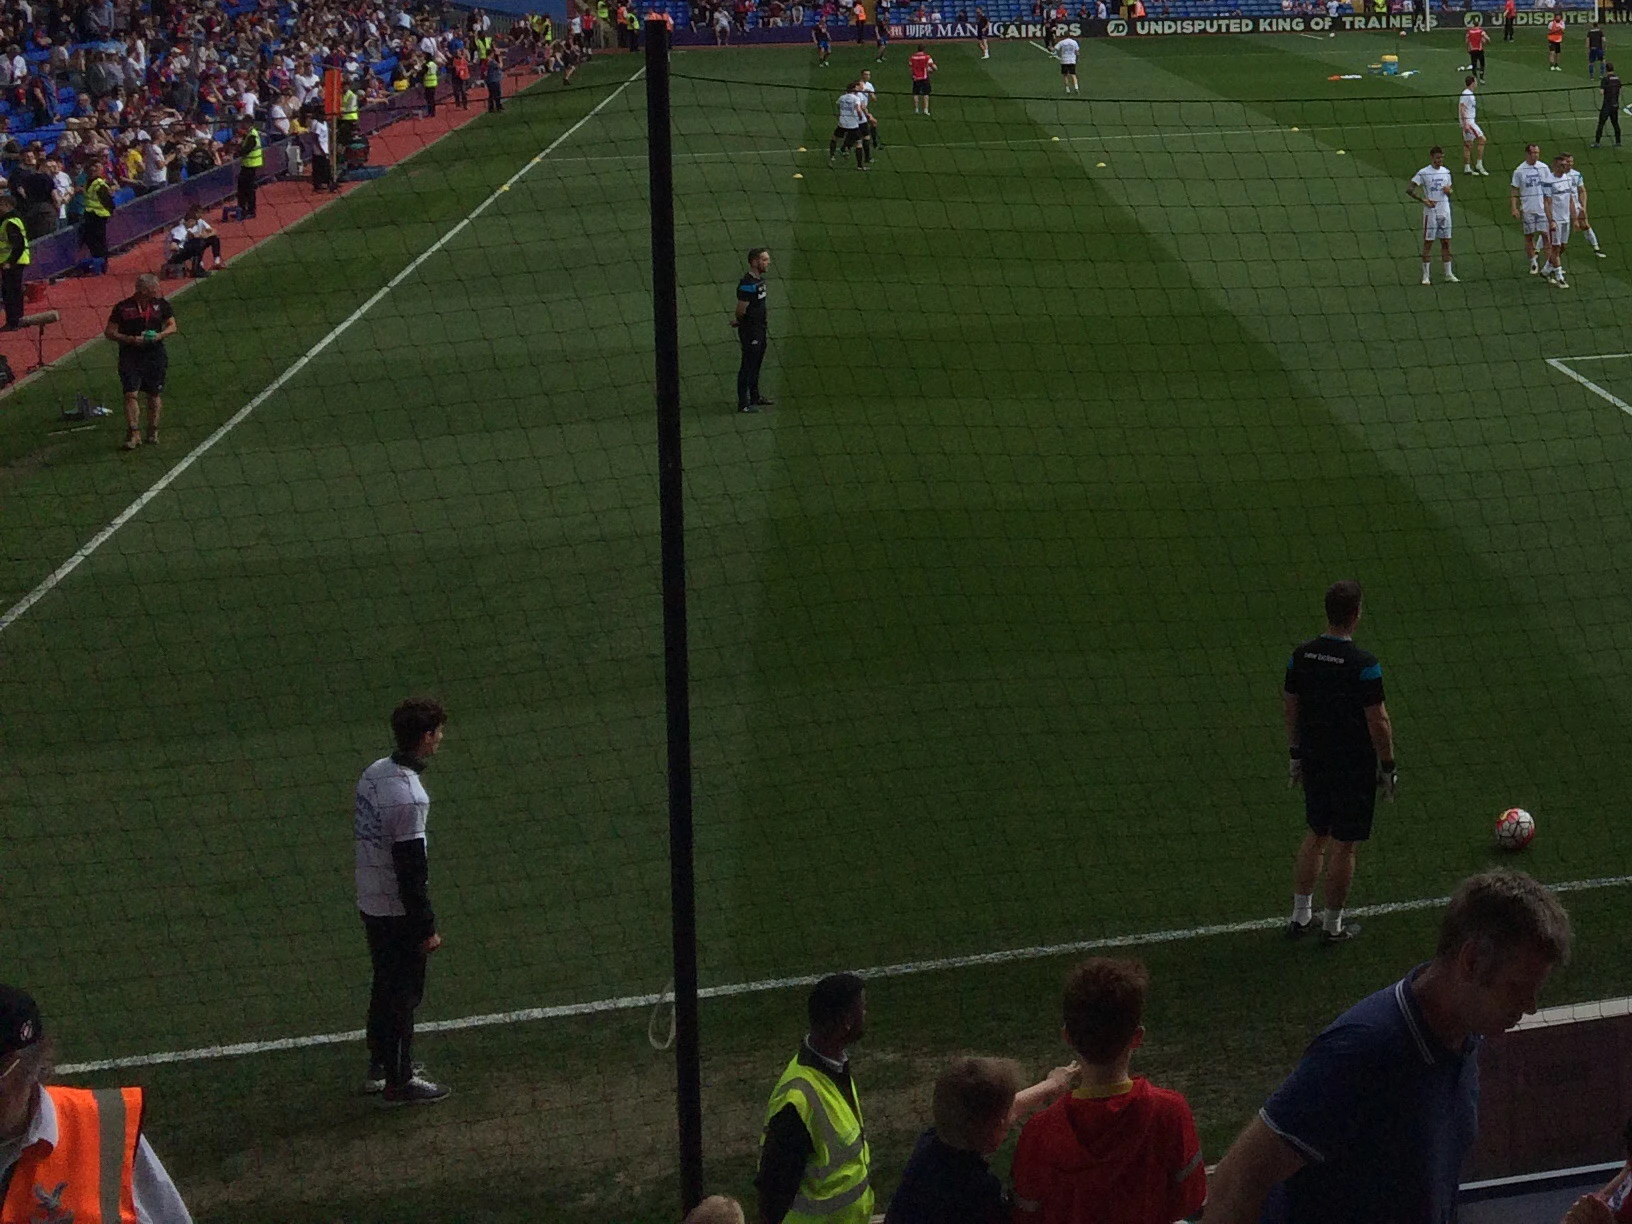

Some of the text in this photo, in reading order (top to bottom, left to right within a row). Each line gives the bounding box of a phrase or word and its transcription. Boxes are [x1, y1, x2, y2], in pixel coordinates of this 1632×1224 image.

[1136, 17, 1253, 35] UNDISPUTED
[1259, 17, 1304, 33] KING
[1310, 17, 1333, 31] OF
[1342, 14, 1438, 30] TRAINES
